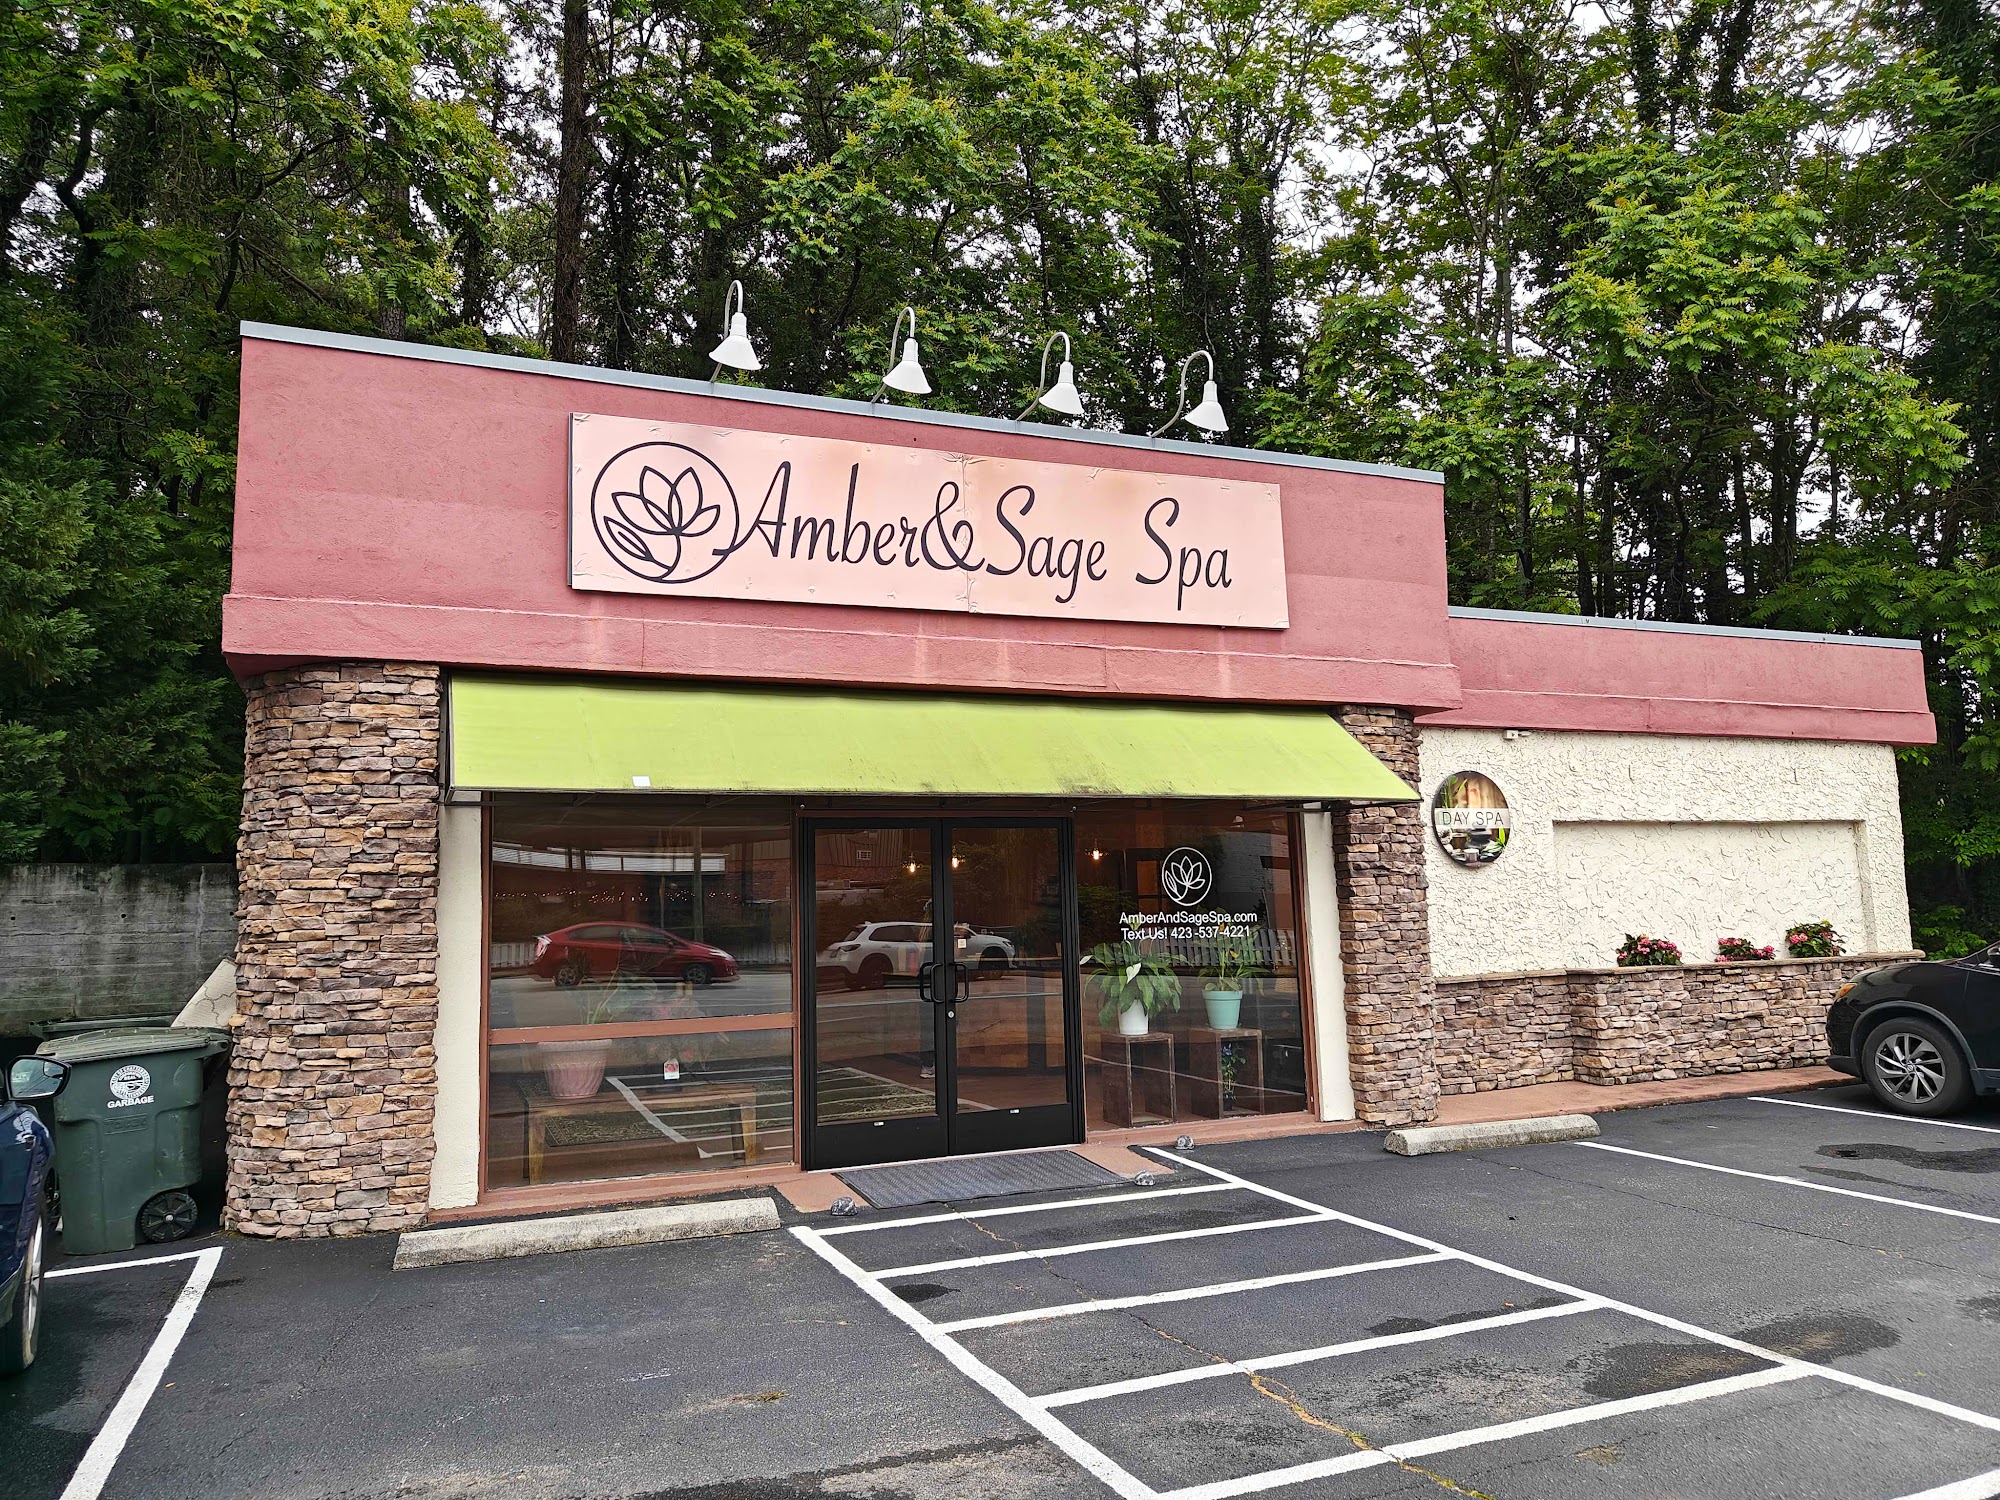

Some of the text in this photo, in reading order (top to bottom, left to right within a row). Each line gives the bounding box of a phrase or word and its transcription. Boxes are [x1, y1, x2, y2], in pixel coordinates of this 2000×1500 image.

[985, 484, 1107, 604] Sage
[1135, 497, 1232, 611] Spa
[1442, 811, 1504, 826] DAY SPA
[1119, 910, 1258, 926] AmberAndSageSpa.com
[1120, 927, 1146, 940] Text
[1148, 926, 1168, 940] Us!
[107, 1095, 155, 1109] GARBAGE
